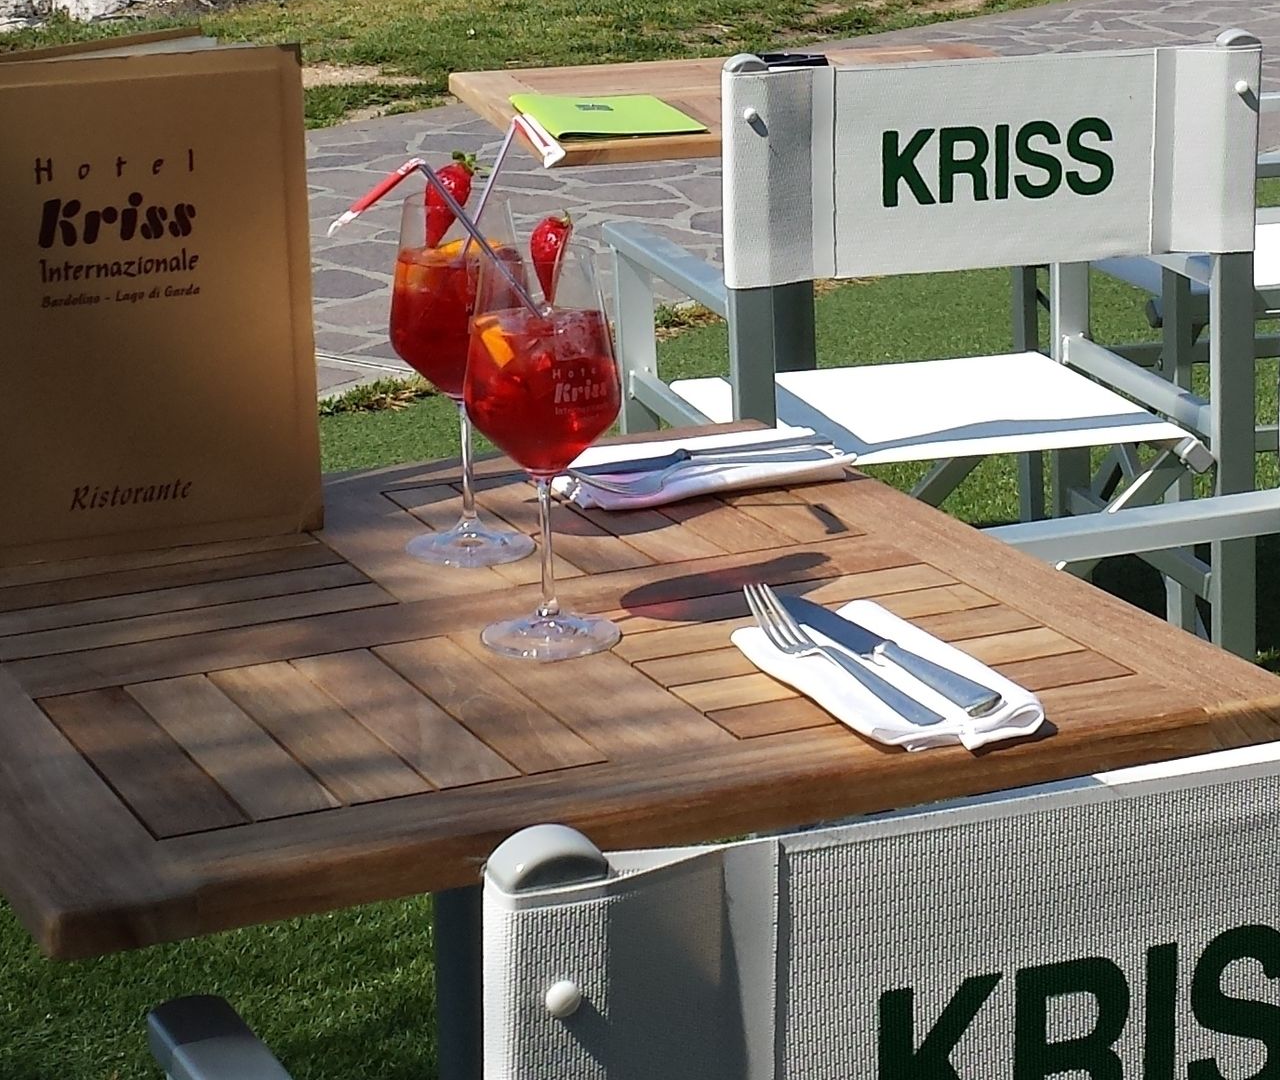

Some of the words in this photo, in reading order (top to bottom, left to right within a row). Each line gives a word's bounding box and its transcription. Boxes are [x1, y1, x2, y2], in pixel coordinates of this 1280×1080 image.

[34, 148, 194, 185] Hotel
[882, 117, 1114, 208] KRISS
[38, 191, 196, 249] Kriss
[38, 247, 199, 284] Internazionale
[41, 293, 101, 309] Bardolino
[115, 290, 145, 304] Lago
[148, 287, 160, 299] di
[164, 283, 201, 298] Garda
[70, 478, 193, 512] Ristorante
